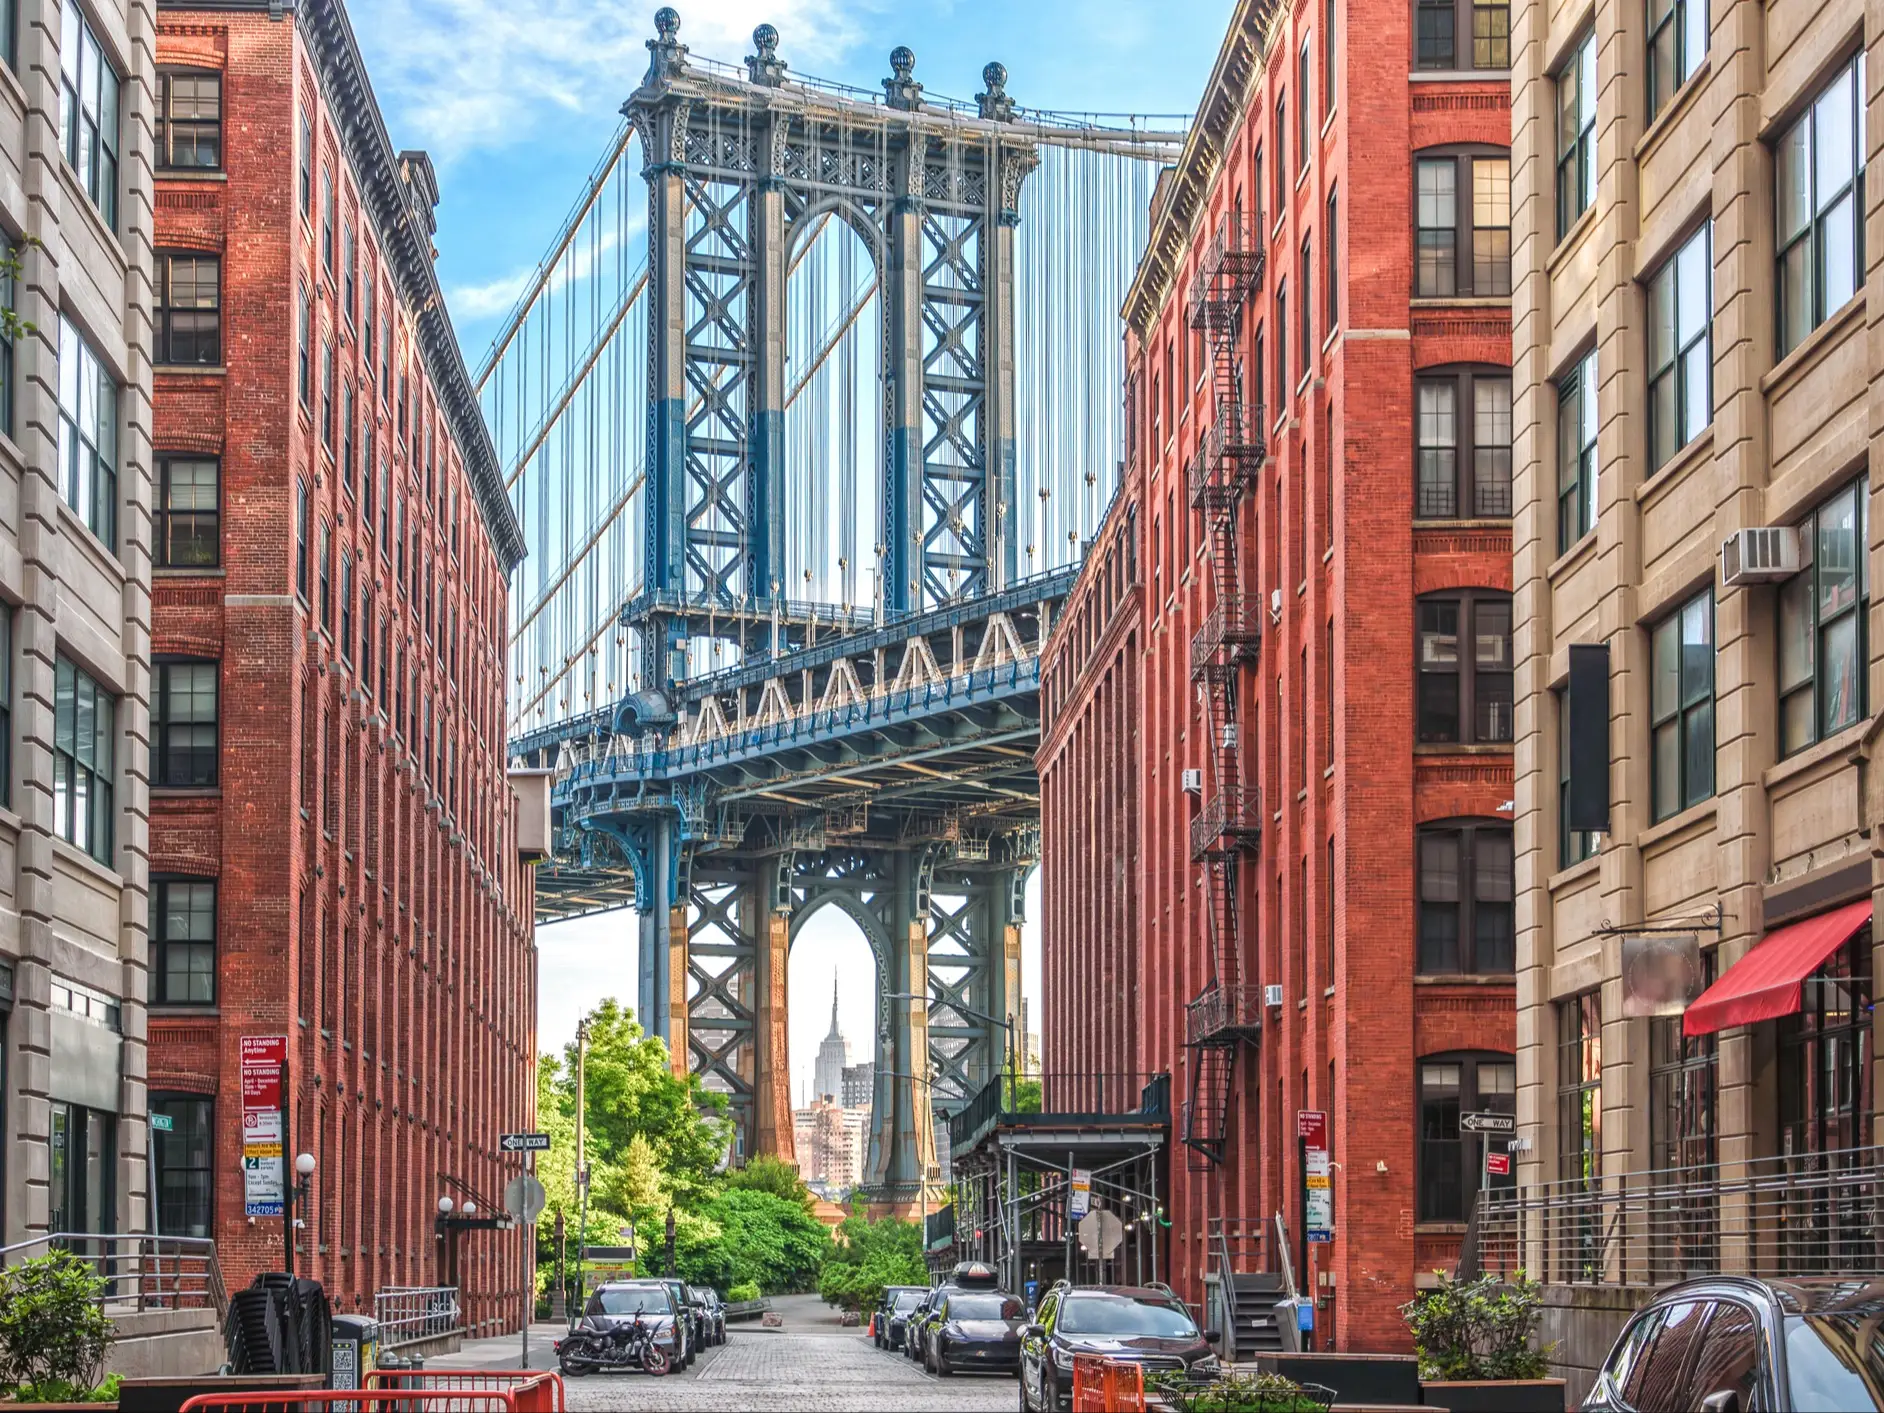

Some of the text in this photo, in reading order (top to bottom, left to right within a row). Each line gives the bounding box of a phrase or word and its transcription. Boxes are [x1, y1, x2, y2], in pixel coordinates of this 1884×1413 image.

[1468, 1119, 1484, 1127] ONE
[508, 1138, 544, 1146] ONE WAY
[249, 1158, 256, 1168] 2
[248, 1206, 273, 1214] 342705
